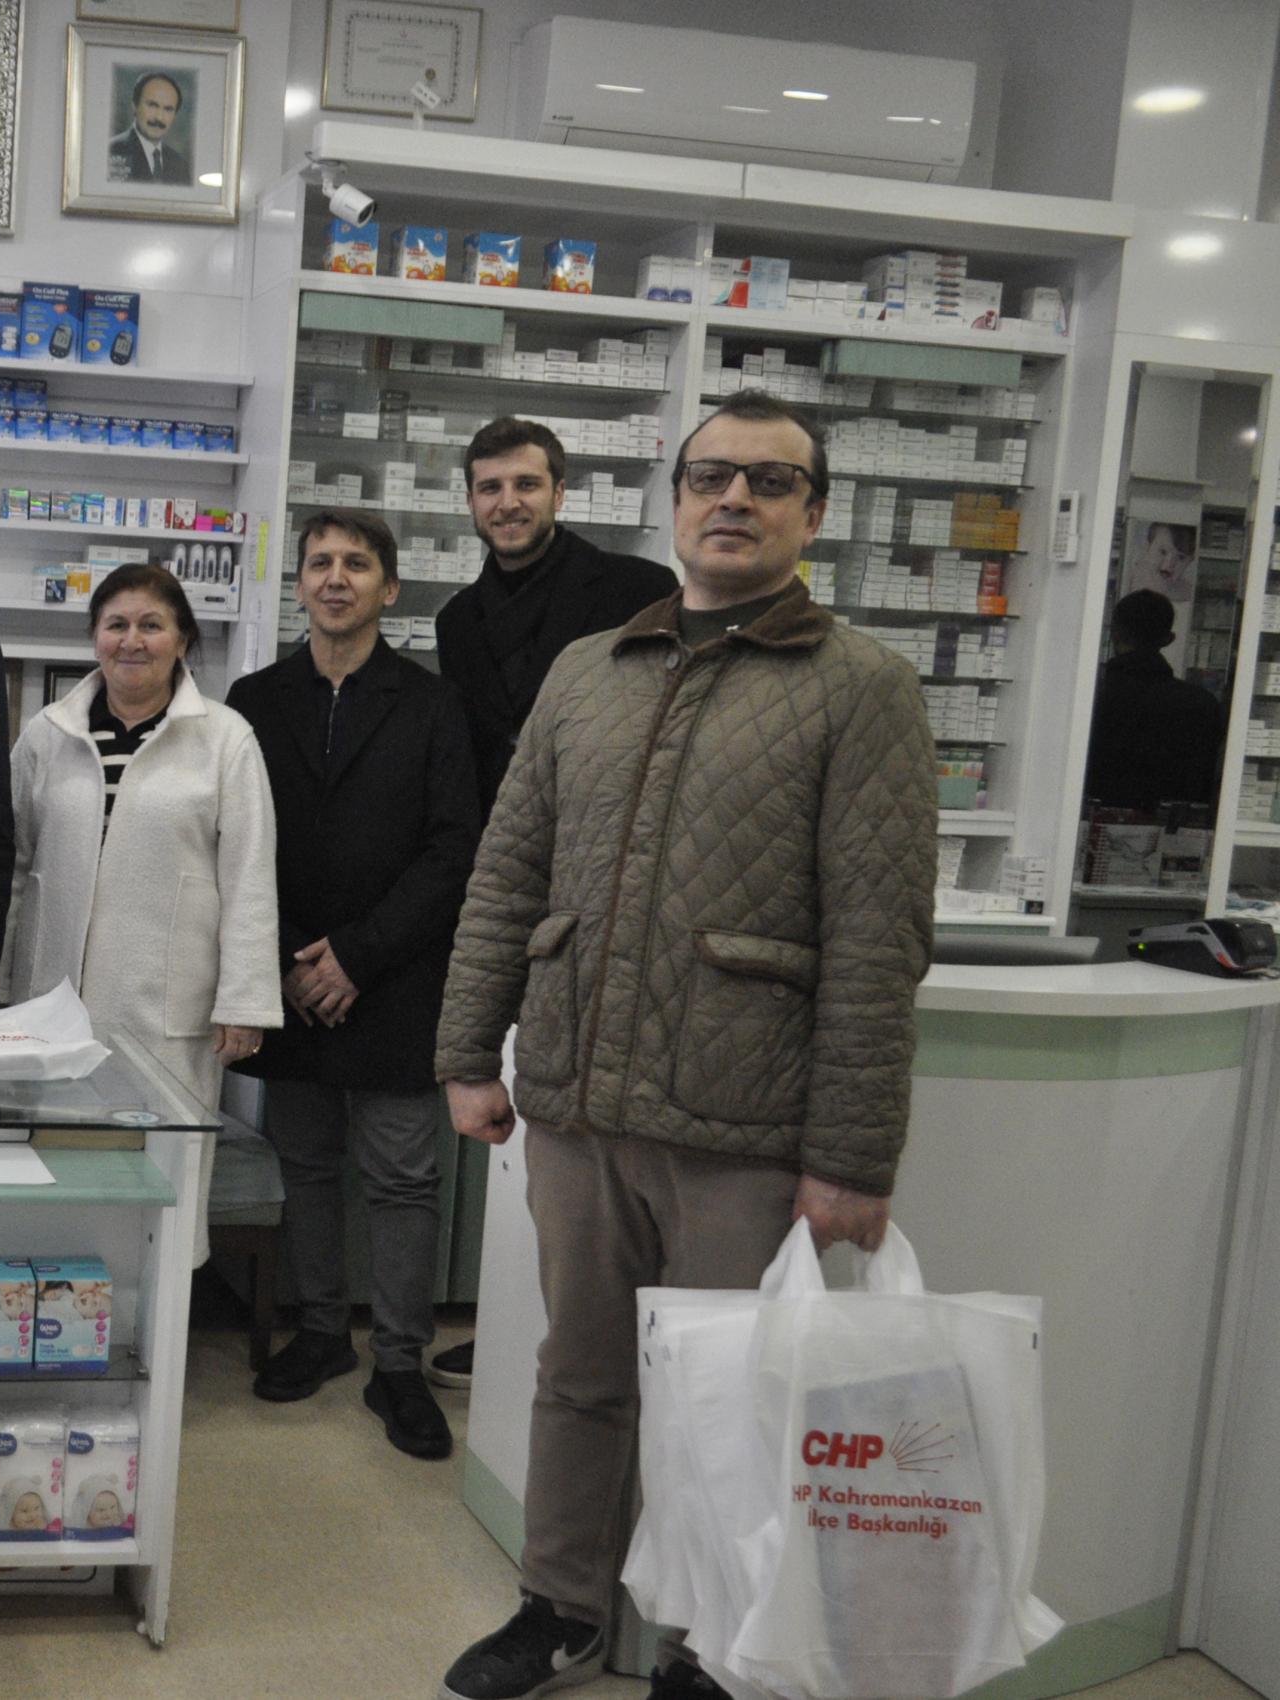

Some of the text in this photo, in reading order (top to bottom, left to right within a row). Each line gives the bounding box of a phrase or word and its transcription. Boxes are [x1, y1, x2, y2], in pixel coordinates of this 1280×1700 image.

[801, 1428, 883, 1469] CHP
[792, 1484, 982, 1514] HP Kahramankazan
[808, 1505, 949, 1540] İlçe Başkanlığı
